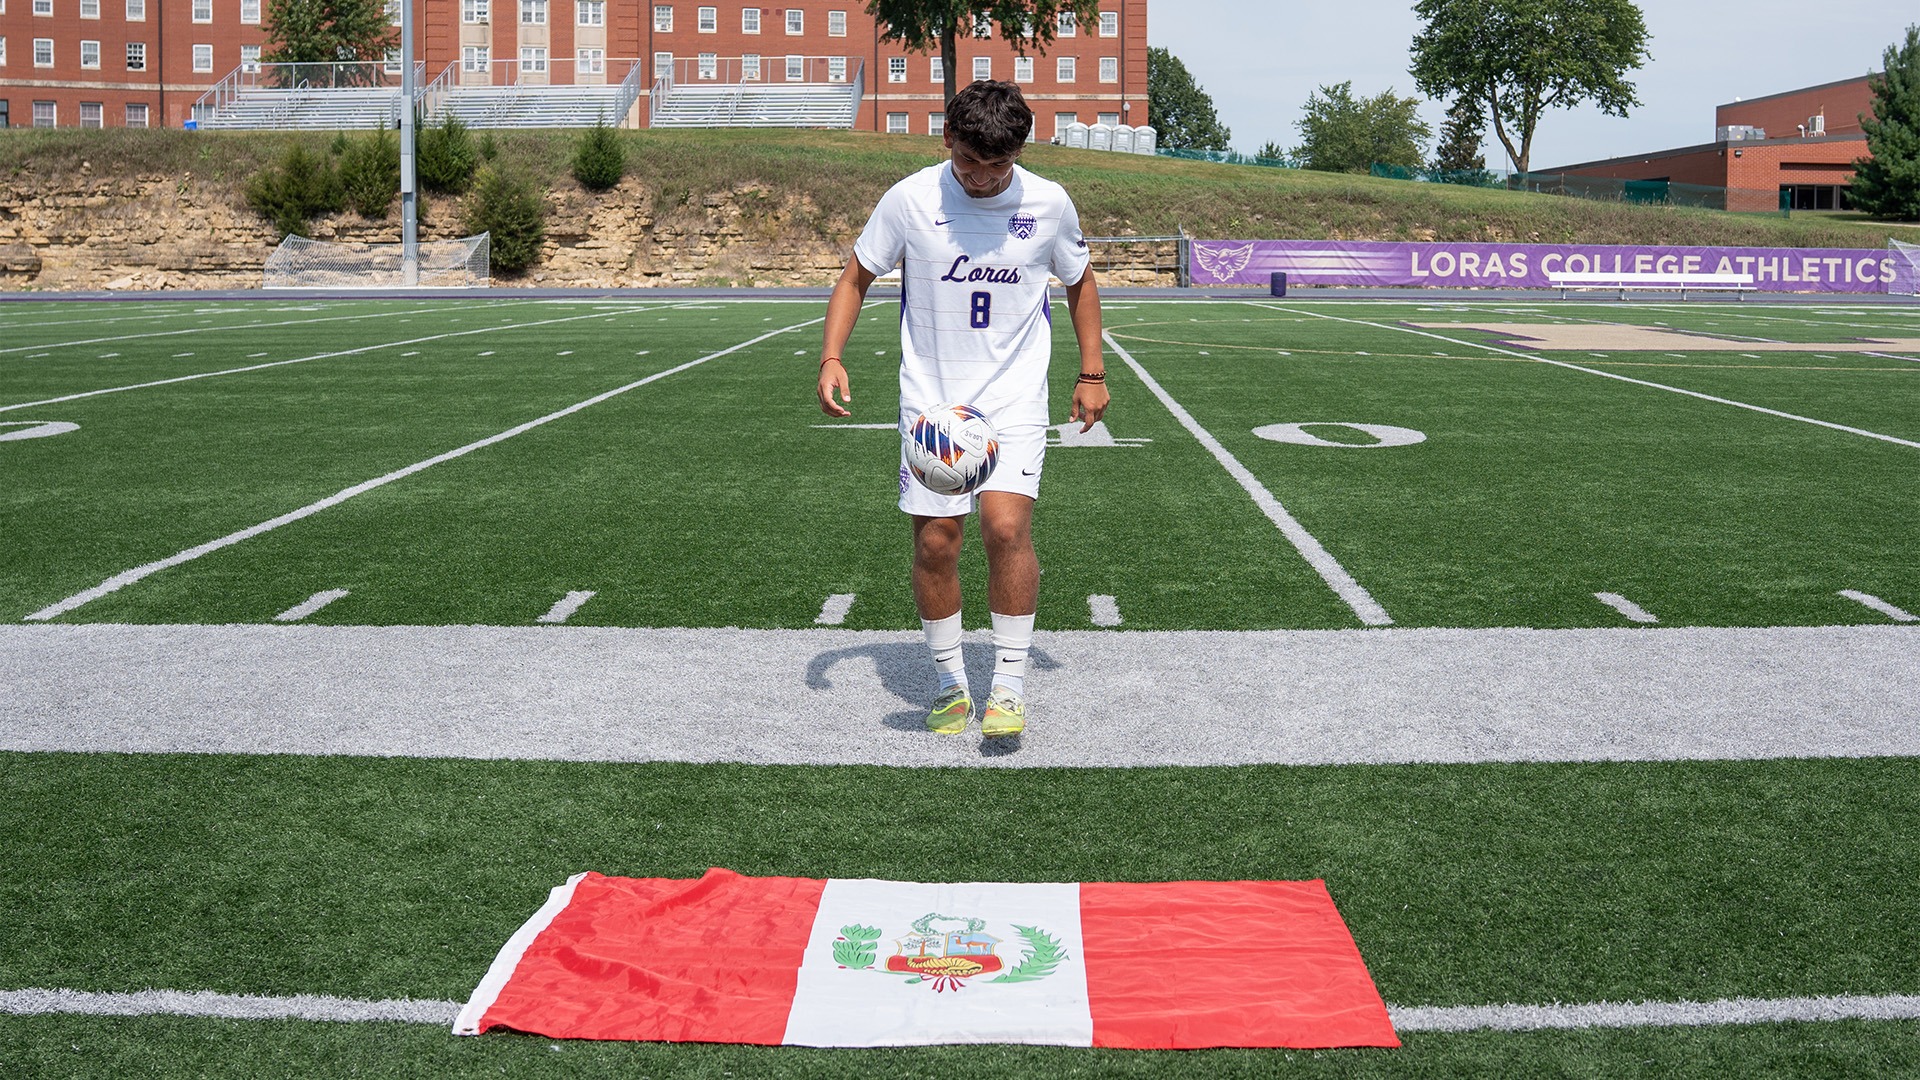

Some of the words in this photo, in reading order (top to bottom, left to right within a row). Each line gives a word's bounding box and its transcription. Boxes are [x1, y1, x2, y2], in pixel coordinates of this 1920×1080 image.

[941, 254, 1022, 285] Loras
[1411, 251, 1528, 278] LORAS
[1715, 255, 1897, 283] ATHLETICS
[970, 291, 991, 329] 8
[964, 430, 983, 442] LORAS
